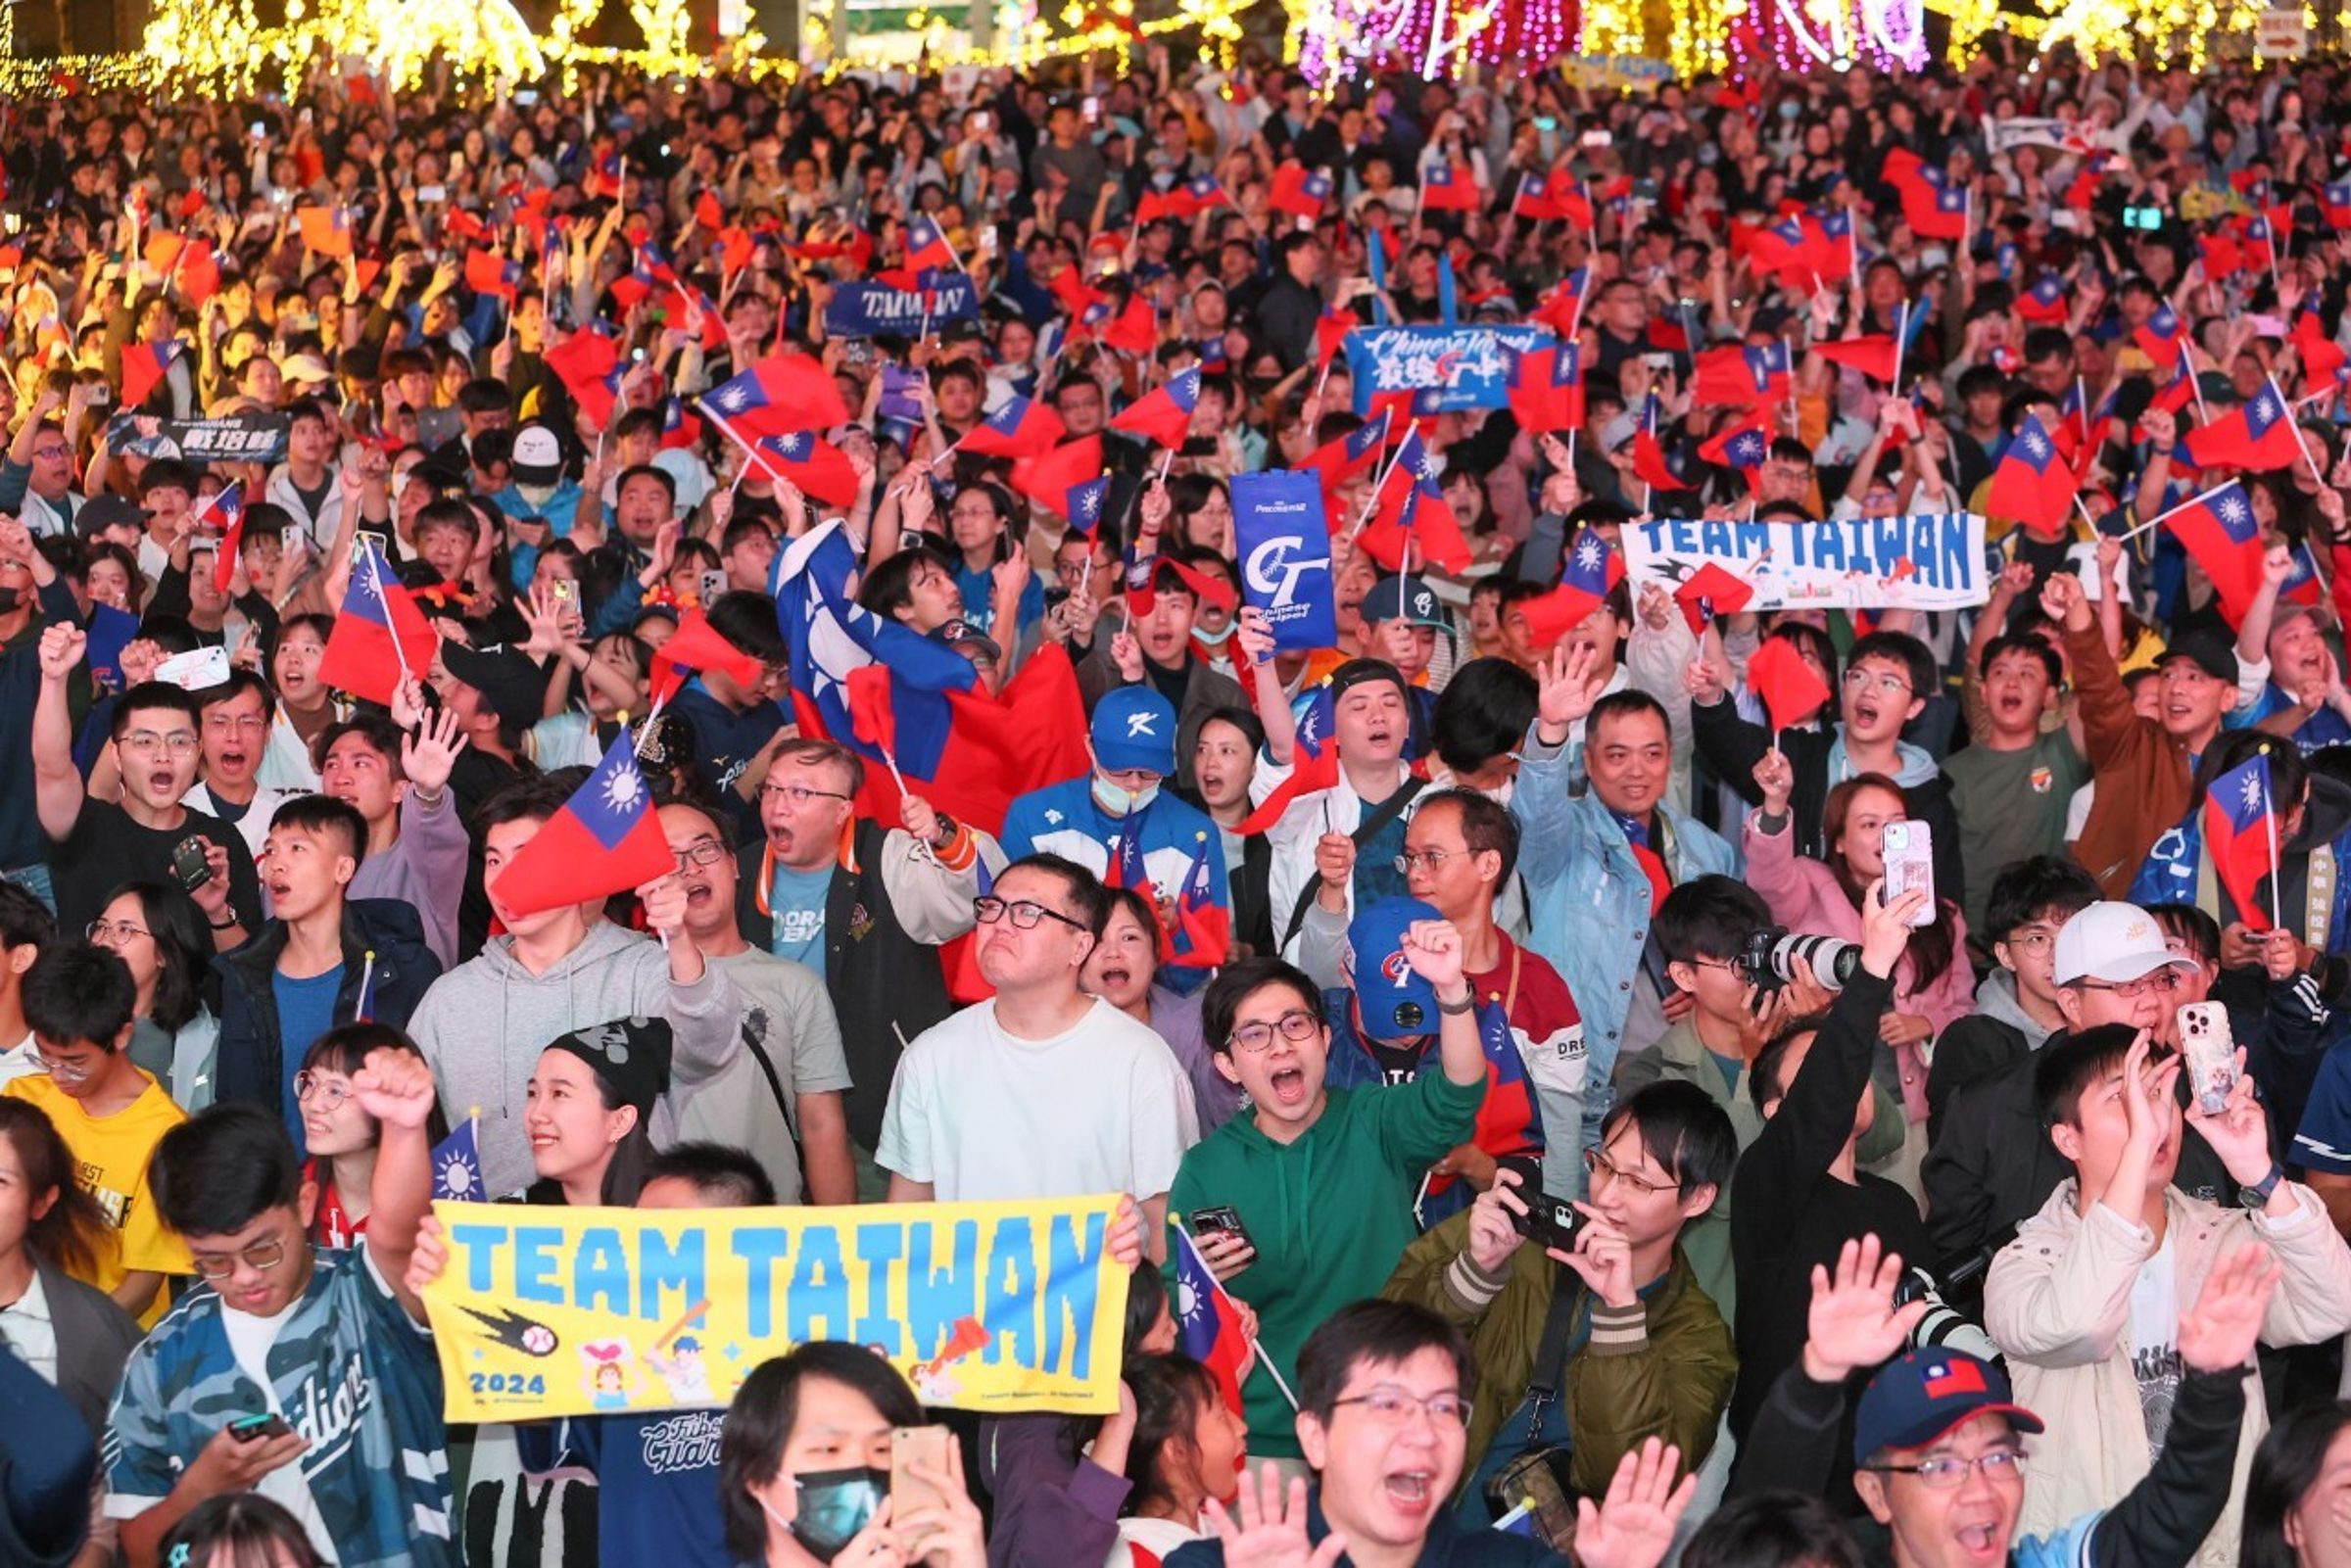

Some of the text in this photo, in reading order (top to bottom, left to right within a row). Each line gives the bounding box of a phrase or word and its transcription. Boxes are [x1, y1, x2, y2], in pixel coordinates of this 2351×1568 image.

[1639, 519, 1771, 560] TEAM
[1792, 512, 1971, 591] TAIWAN
[452, 1224, 706, 1330] TEAM
[732, 1212, 1107, 1380] TAIWAN
[469, 1371, 546, 1394] 2024
